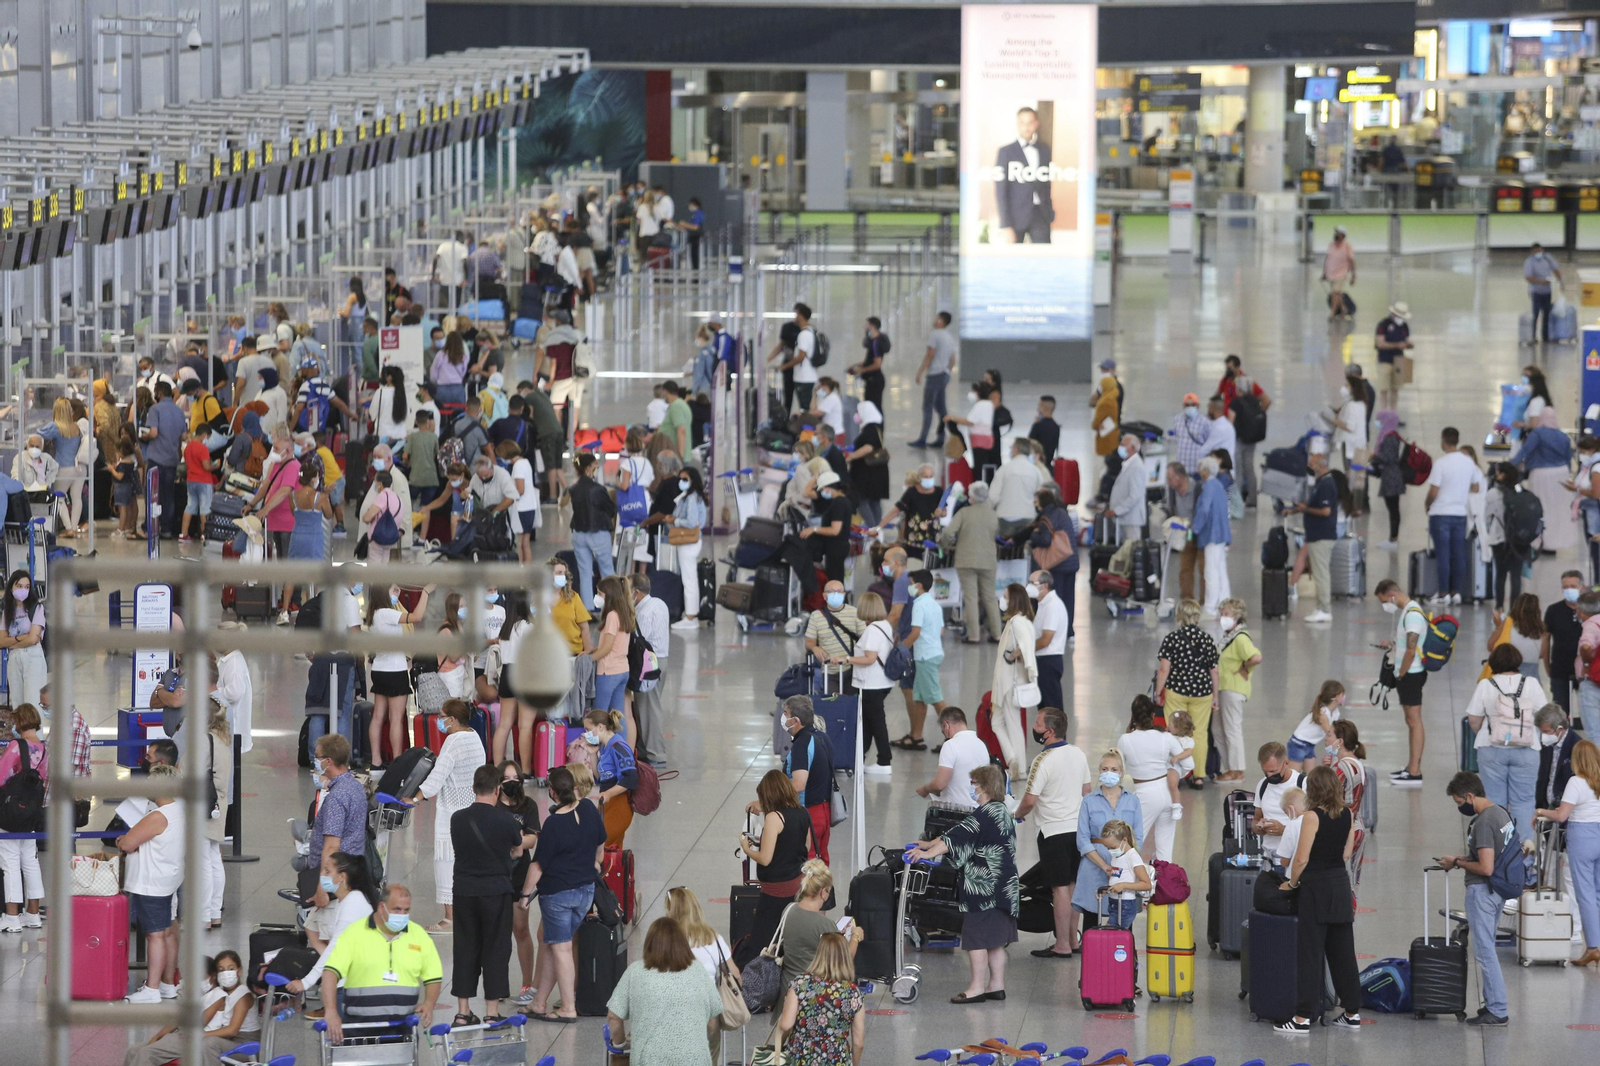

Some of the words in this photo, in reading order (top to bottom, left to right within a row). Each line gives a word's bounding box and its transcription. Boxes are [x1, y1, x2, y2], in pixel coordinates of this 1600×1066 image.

[33, 198, 42, 222] 335
[50, 193, 59, 217] 336
[75, 189, 84, 211] 337
[2, 204, 13, 229] 334
[1360, 968, 1382, 983] EAD
